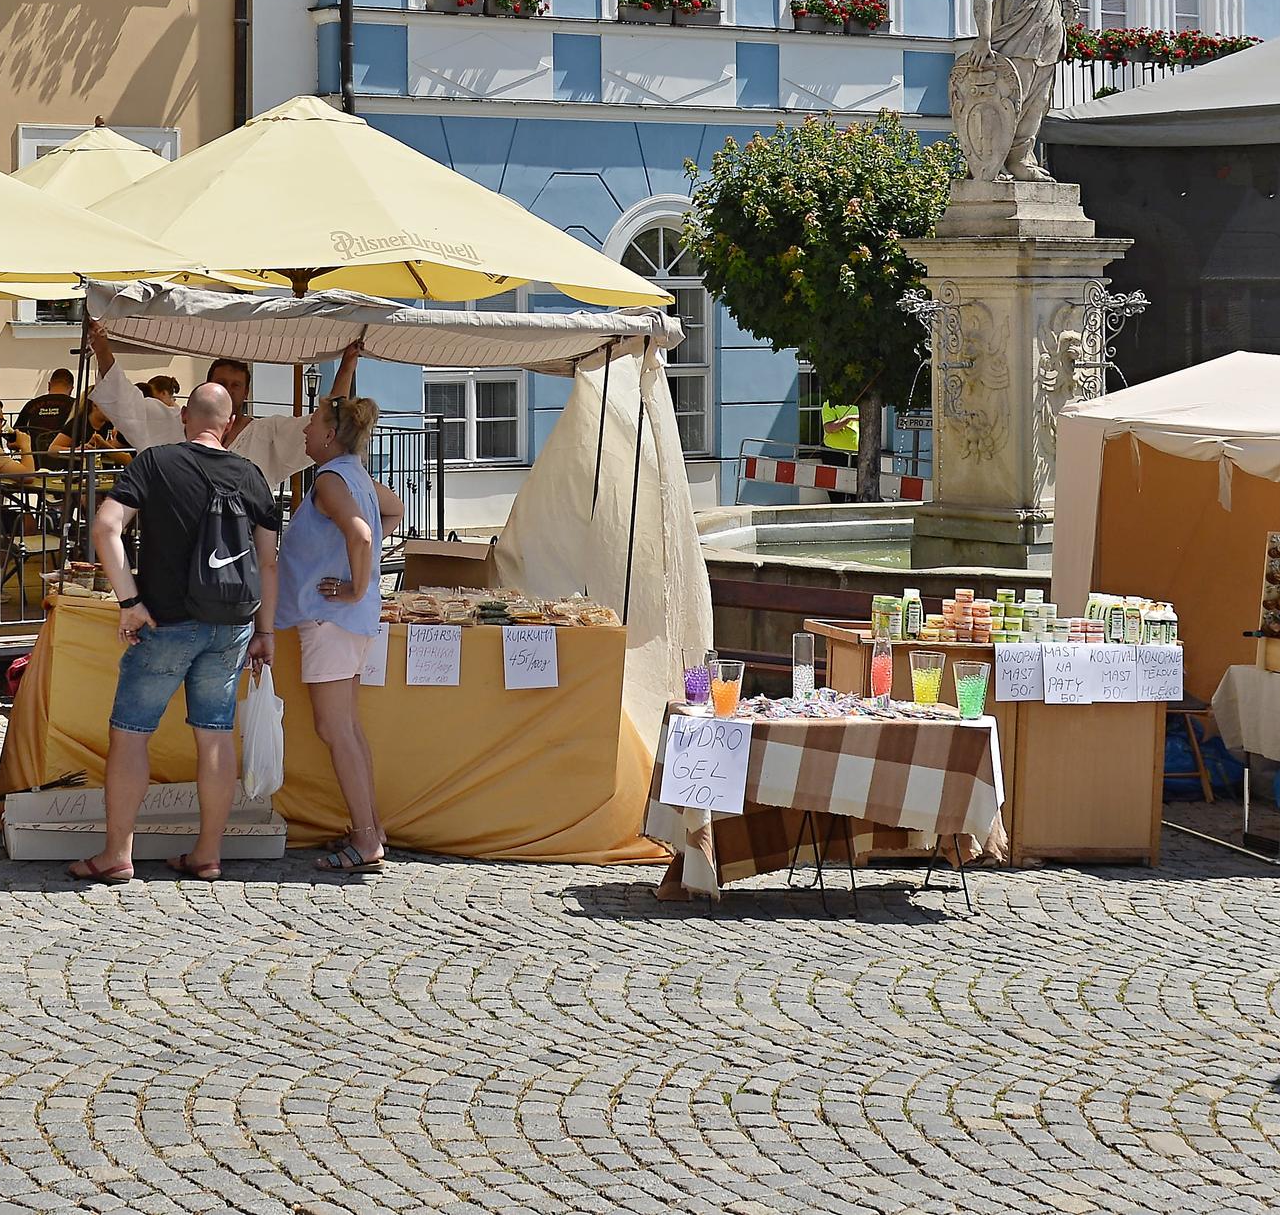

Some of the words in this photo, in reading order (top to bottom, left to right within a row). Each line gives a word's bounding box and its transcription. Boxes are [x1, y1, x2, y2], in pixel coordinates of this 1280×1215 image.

[330, 230, 407, 260] Pilsner
[402, 229, 479, 259] Urquell
[1044, 645, 1080, 658] MAST
[1002, 668, 1035, 681] MAST
[1056, 662, 1072, 673] NA
[1102, 670, 1132, 682] MAST
[1048, 677, 1084, 693] PATY
[668, 721, 743, 751] HYDRO
[673, 752, 727, 779] GEL
[47, 793, 87, 816] NA
